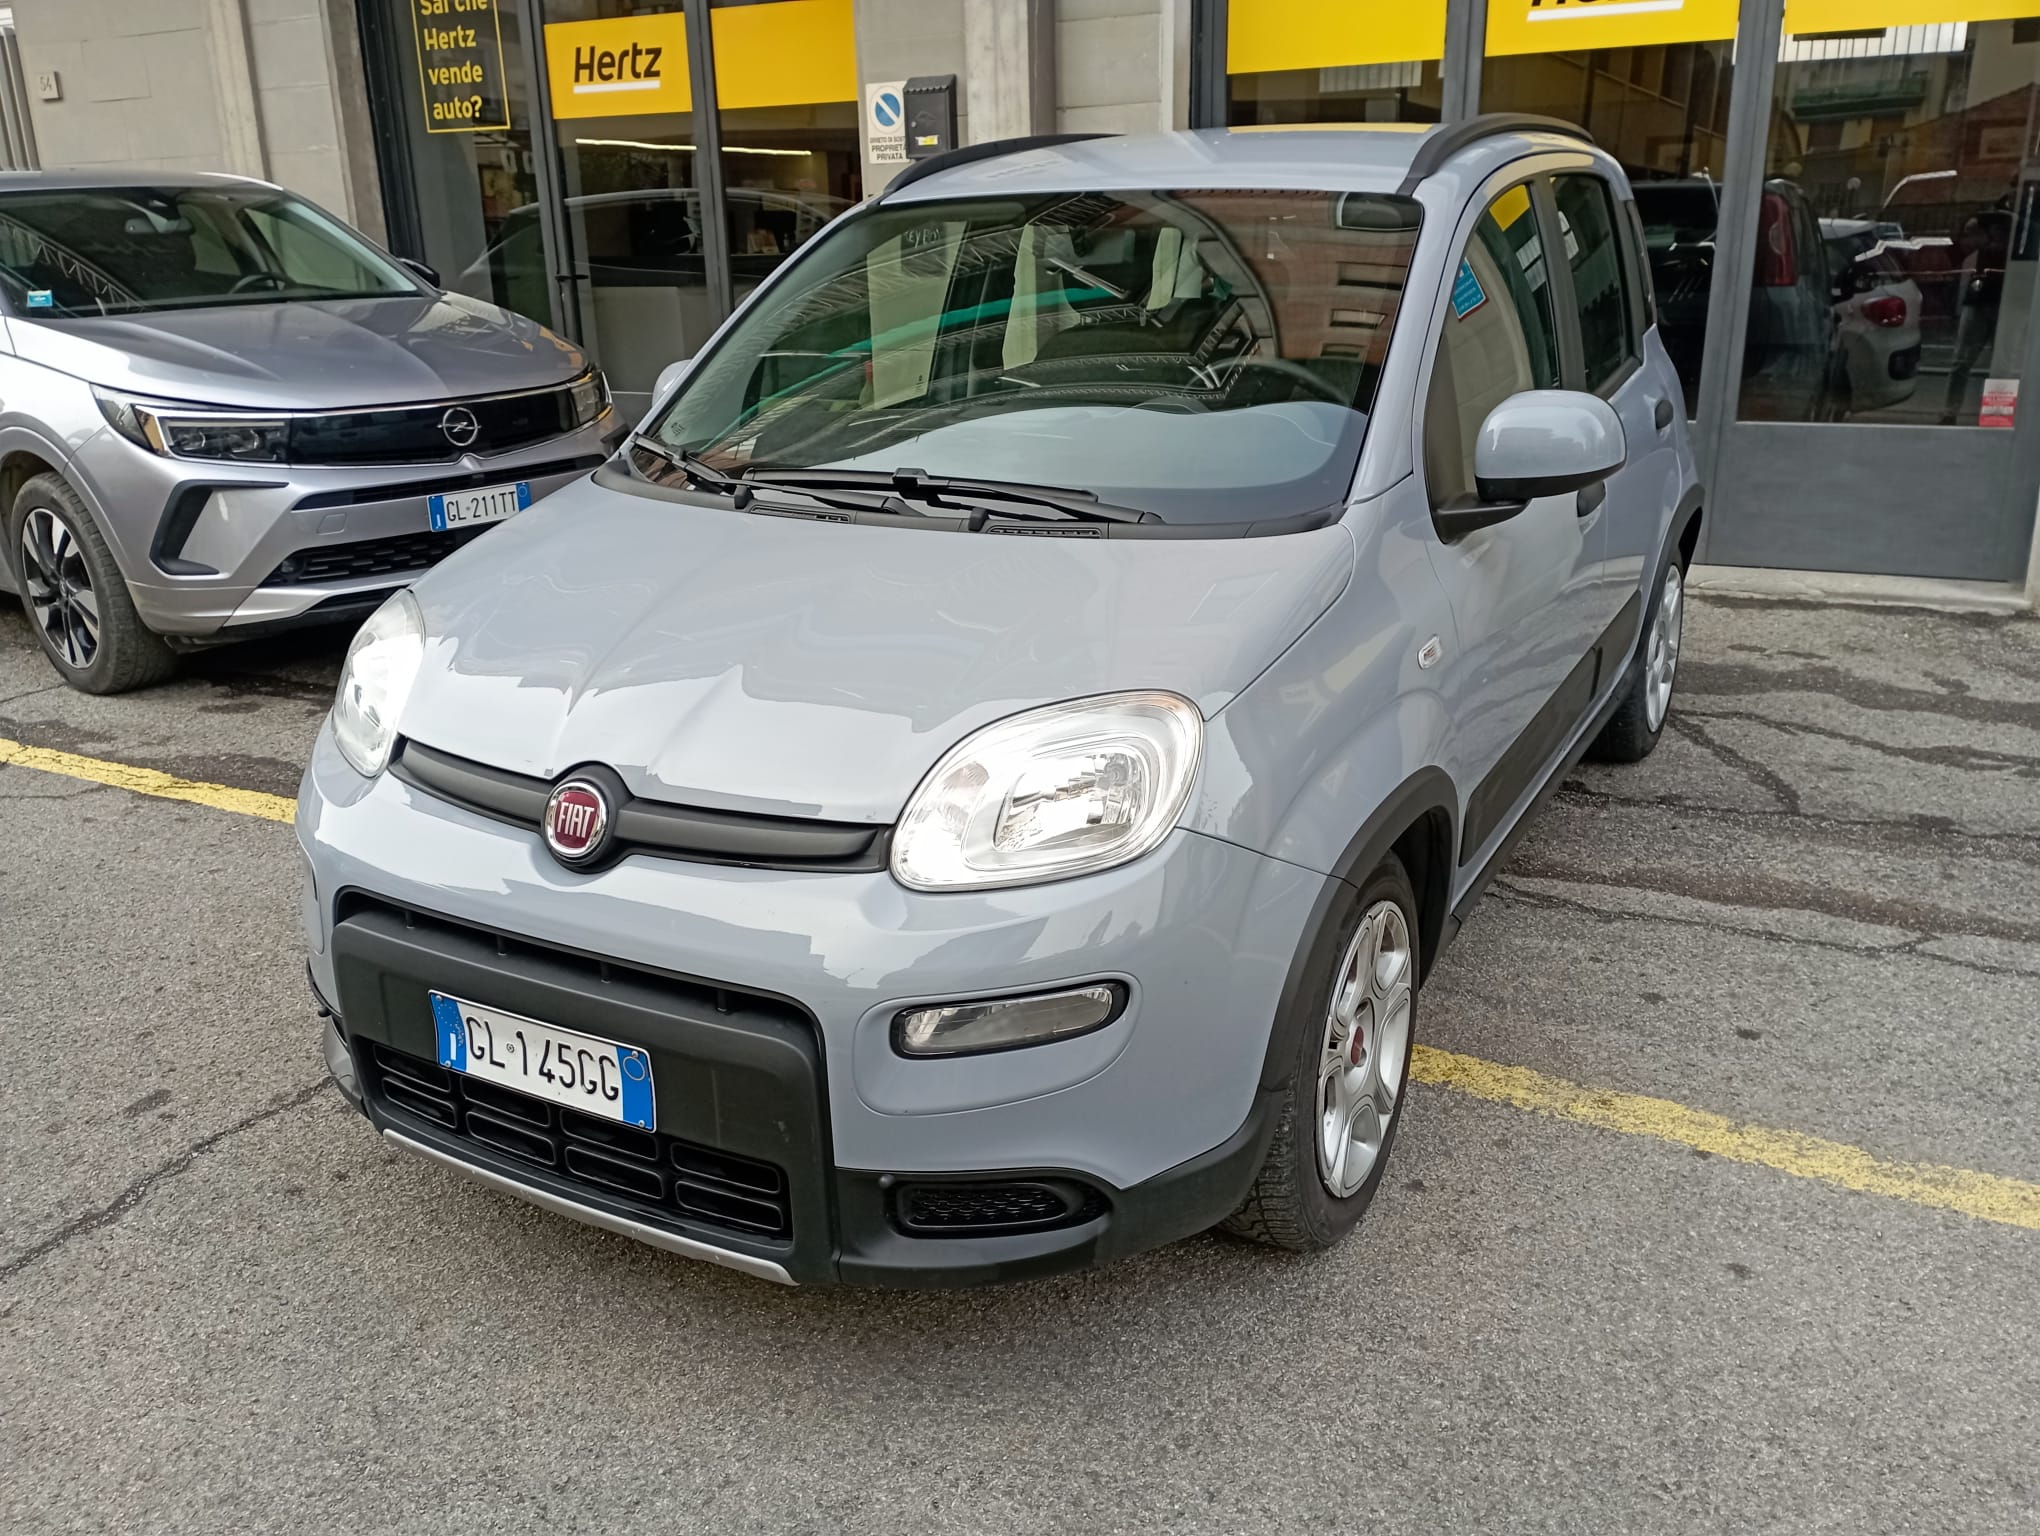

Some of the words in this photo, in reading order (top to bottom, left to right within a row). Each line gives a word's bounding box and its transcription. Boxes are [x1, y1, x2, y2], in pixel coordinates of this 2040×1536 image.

[423, 25, 477, 50] Hertz
[428, 60, 483, 86] vende
[573, 42, 662, 83] Hertz
[433, 95, 483, 120] auto?
[446, 500, 467, 521] GL
[470, 491, 516, 518] 211TT
[557, 802, 595, 838] FIAT
[465, 1016, 506, 1069] GL
[515, 1030, 619, 1100] 145GG
